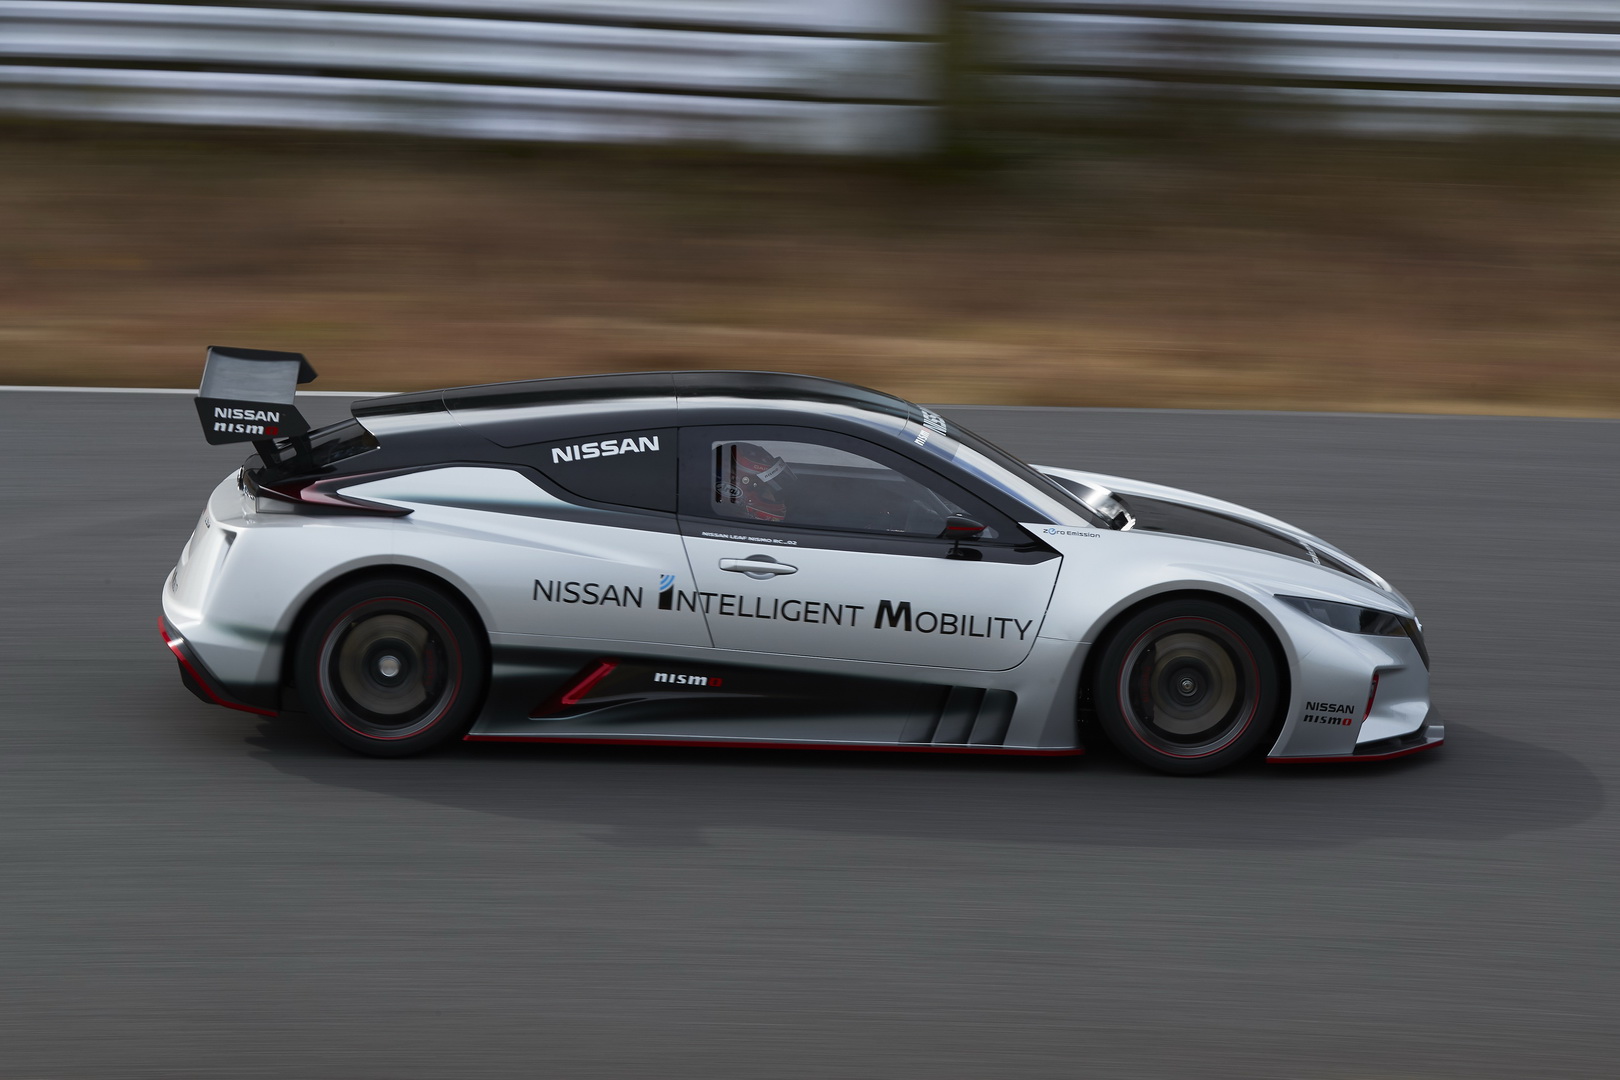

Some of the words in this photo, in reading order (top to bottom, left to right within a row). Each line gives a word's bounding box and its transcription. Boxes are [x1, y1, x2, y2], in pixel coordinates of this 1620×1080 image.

[214, 407, 280, 422] NISSAN
[213, 422, 279, 435] nismo
[551, 436, 660, 464] NISSAN
[701, 531, 729, 539] NISSAN
[748, 536, 773, 544] NISMO
[1066, 530, 1101, 538] Emission
[532, 578, 644, 608] NISSAN
[658, 574, 864, 627] INTELLIGENT
[874, 599, 1034, 641] MOBILITY
[654, 671, 723, 688] nismo
[1305, 701, 1355, 714] NISSAN
[1303, 714, 1352, 726] nismo
